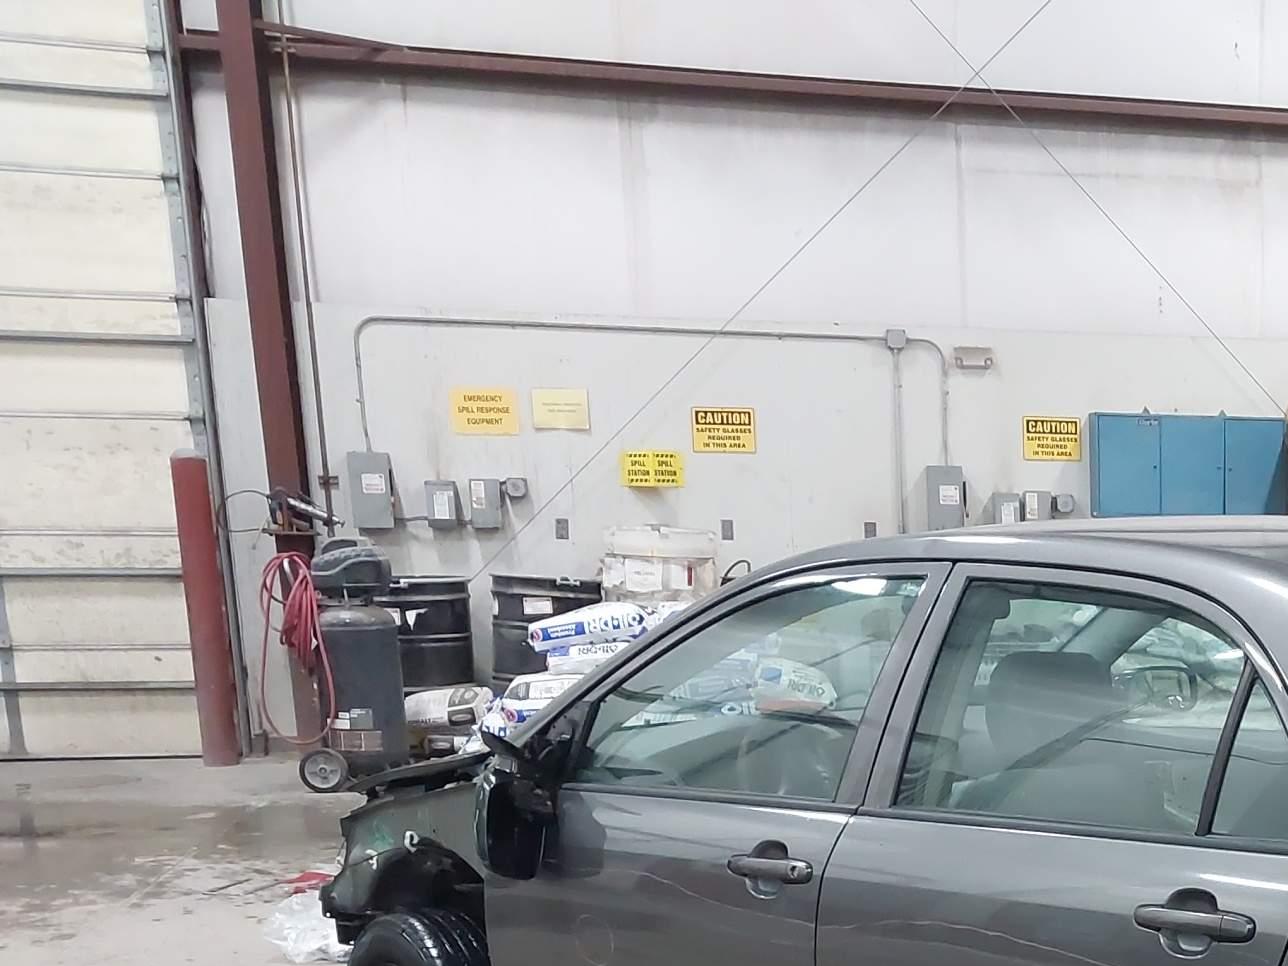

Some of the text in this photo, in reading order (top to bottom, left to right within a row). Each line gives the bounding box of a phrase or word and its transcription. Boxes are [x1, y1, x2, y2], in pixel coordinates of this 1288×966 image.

[463, 394, 502, 402] EMERGENCY
[457, 406, 510, 414] SPILL RESPONSE
[467, 417, 503, 425] EQUIPMENT
[697, 412, 750, 425] CAUTION
[1028, 420, 1076, 434] CAUTION
